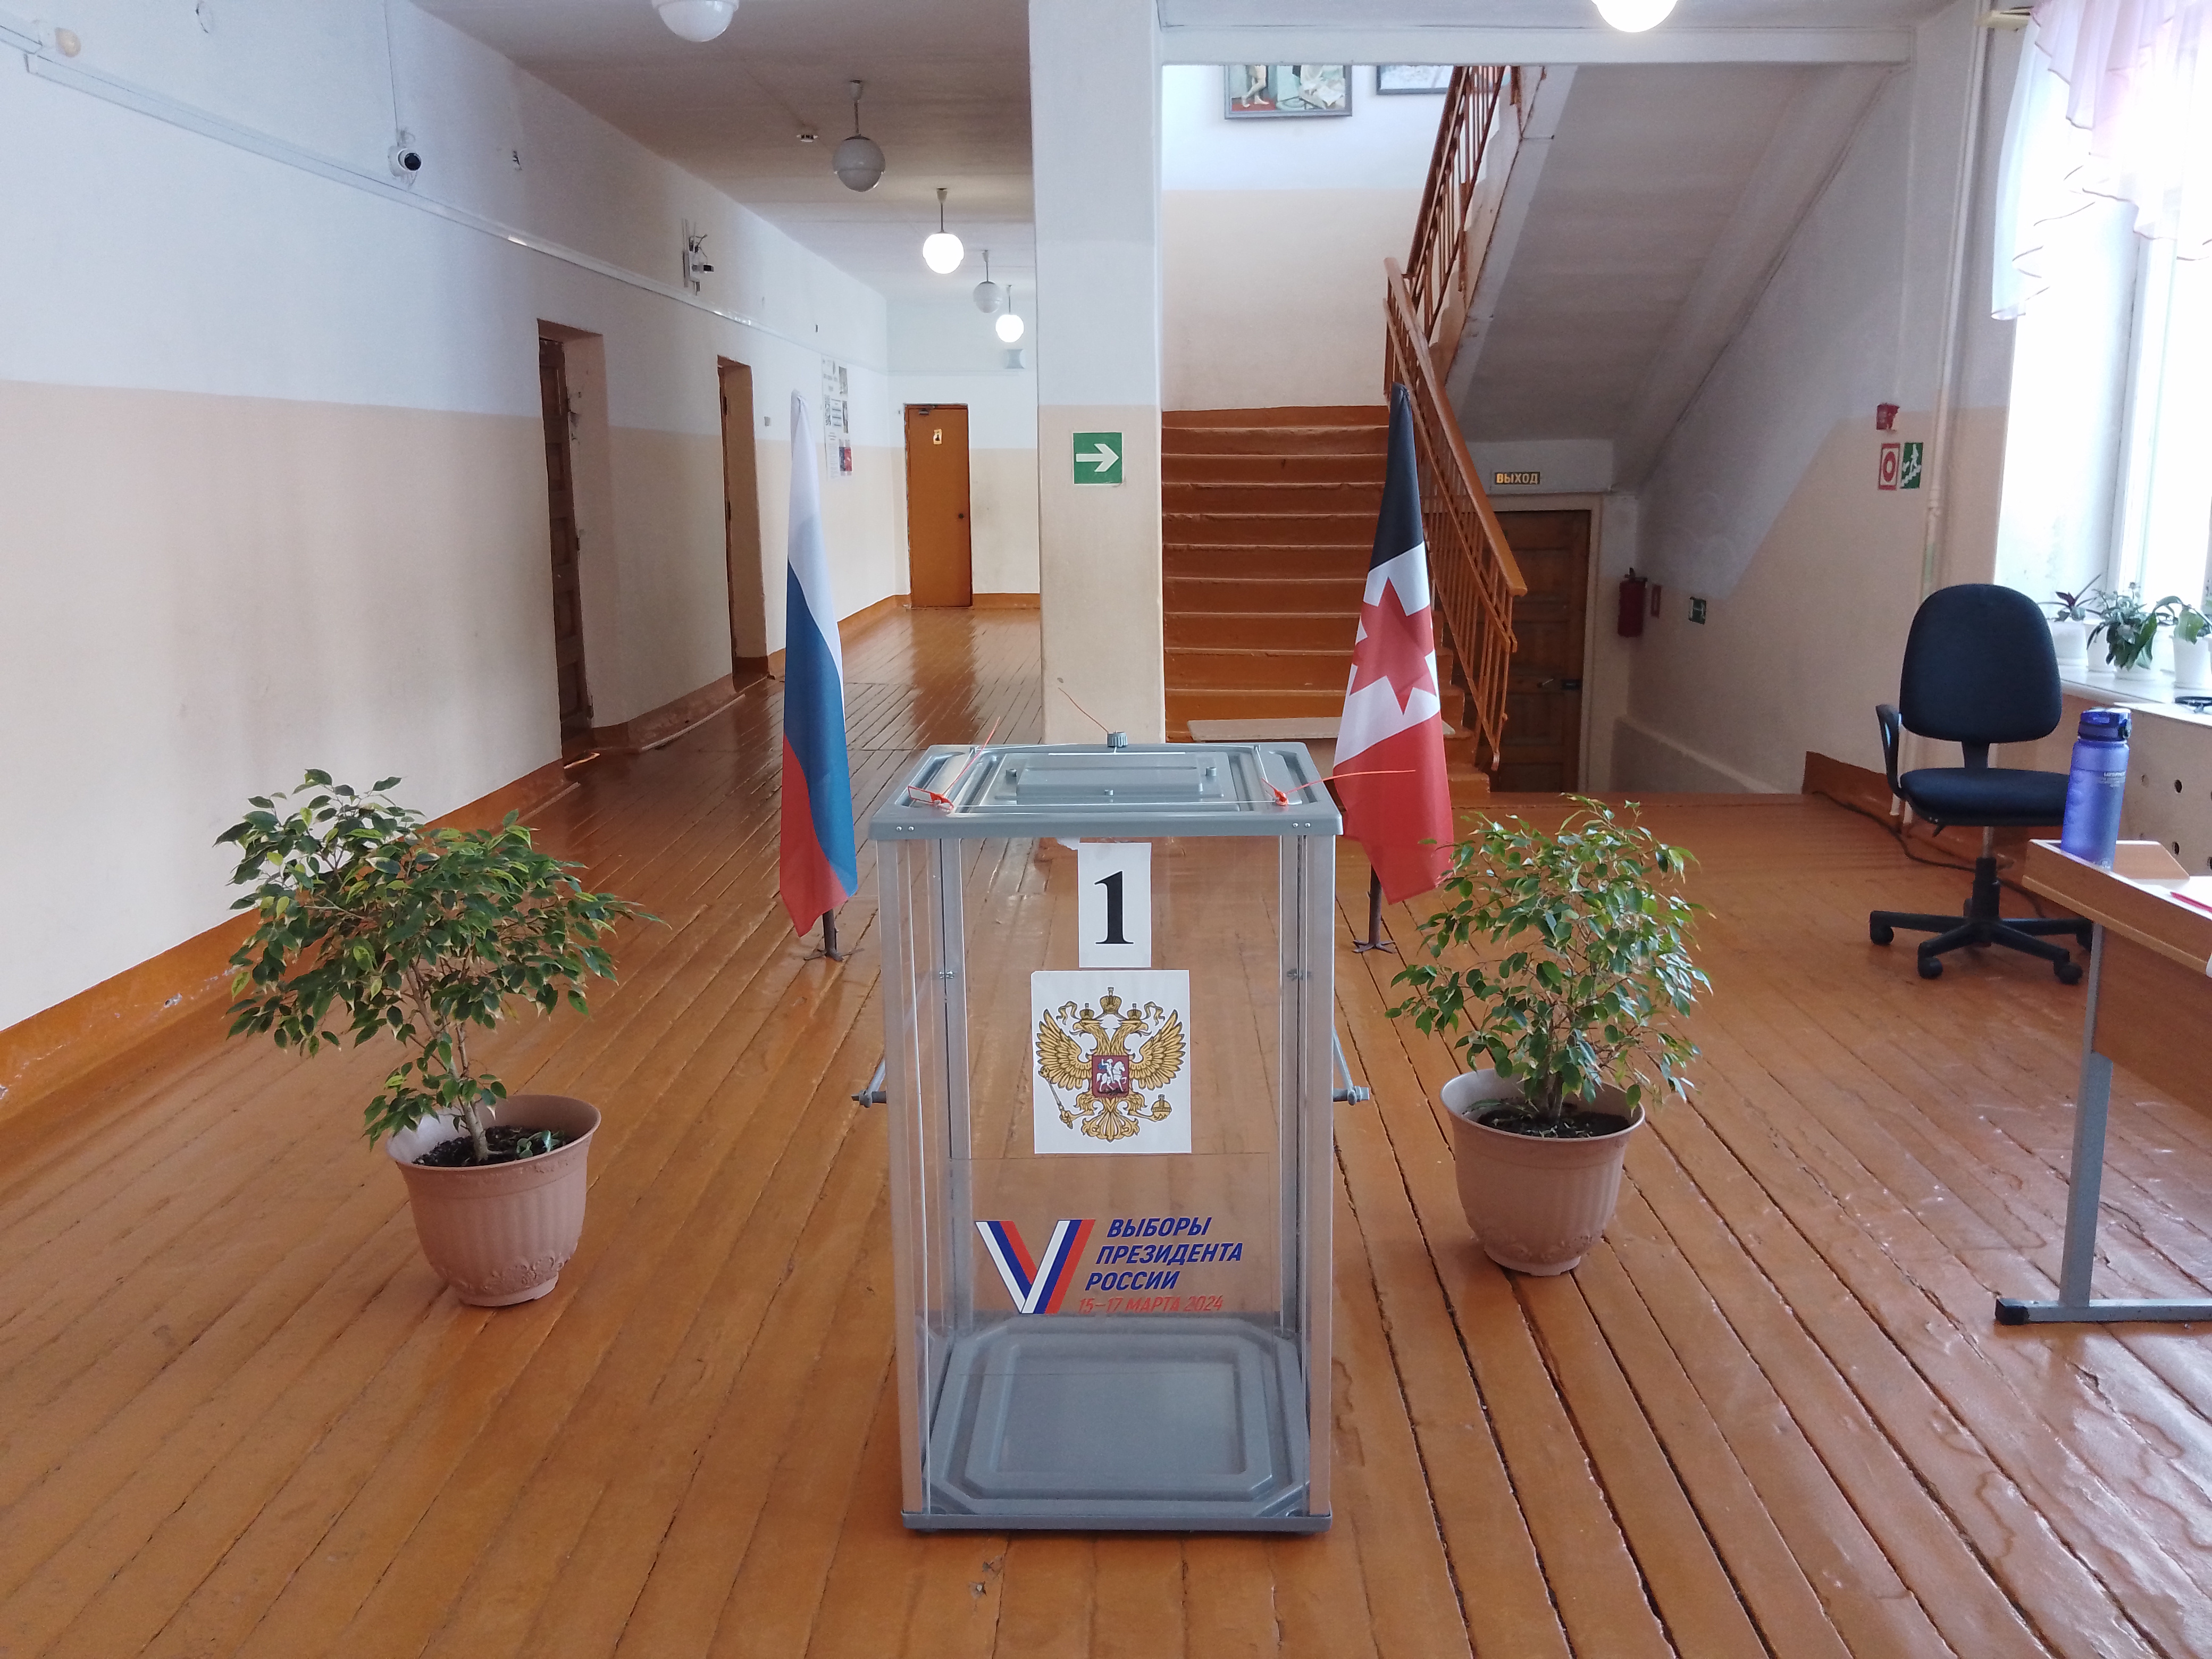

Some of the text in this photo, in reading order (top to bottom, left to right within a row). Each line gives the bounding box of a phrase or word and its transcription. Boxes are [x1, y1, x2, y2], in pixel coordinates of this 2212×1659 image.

[1496, 473, 1538, 484] ВЫХОД
[1094, 870, 1135, 945] 1
[1107, 1217, 1212, 1238] ВЫБОРЫ
[1095, 1242, 1243, 1266] ПРЕЗИДЕНТА
[1085, 1271, 1180, 1291] РОССИИ
[1124, 1296, 1180, 1313] МАРТА
[1183, 1295, 1223, 1312] 2024
